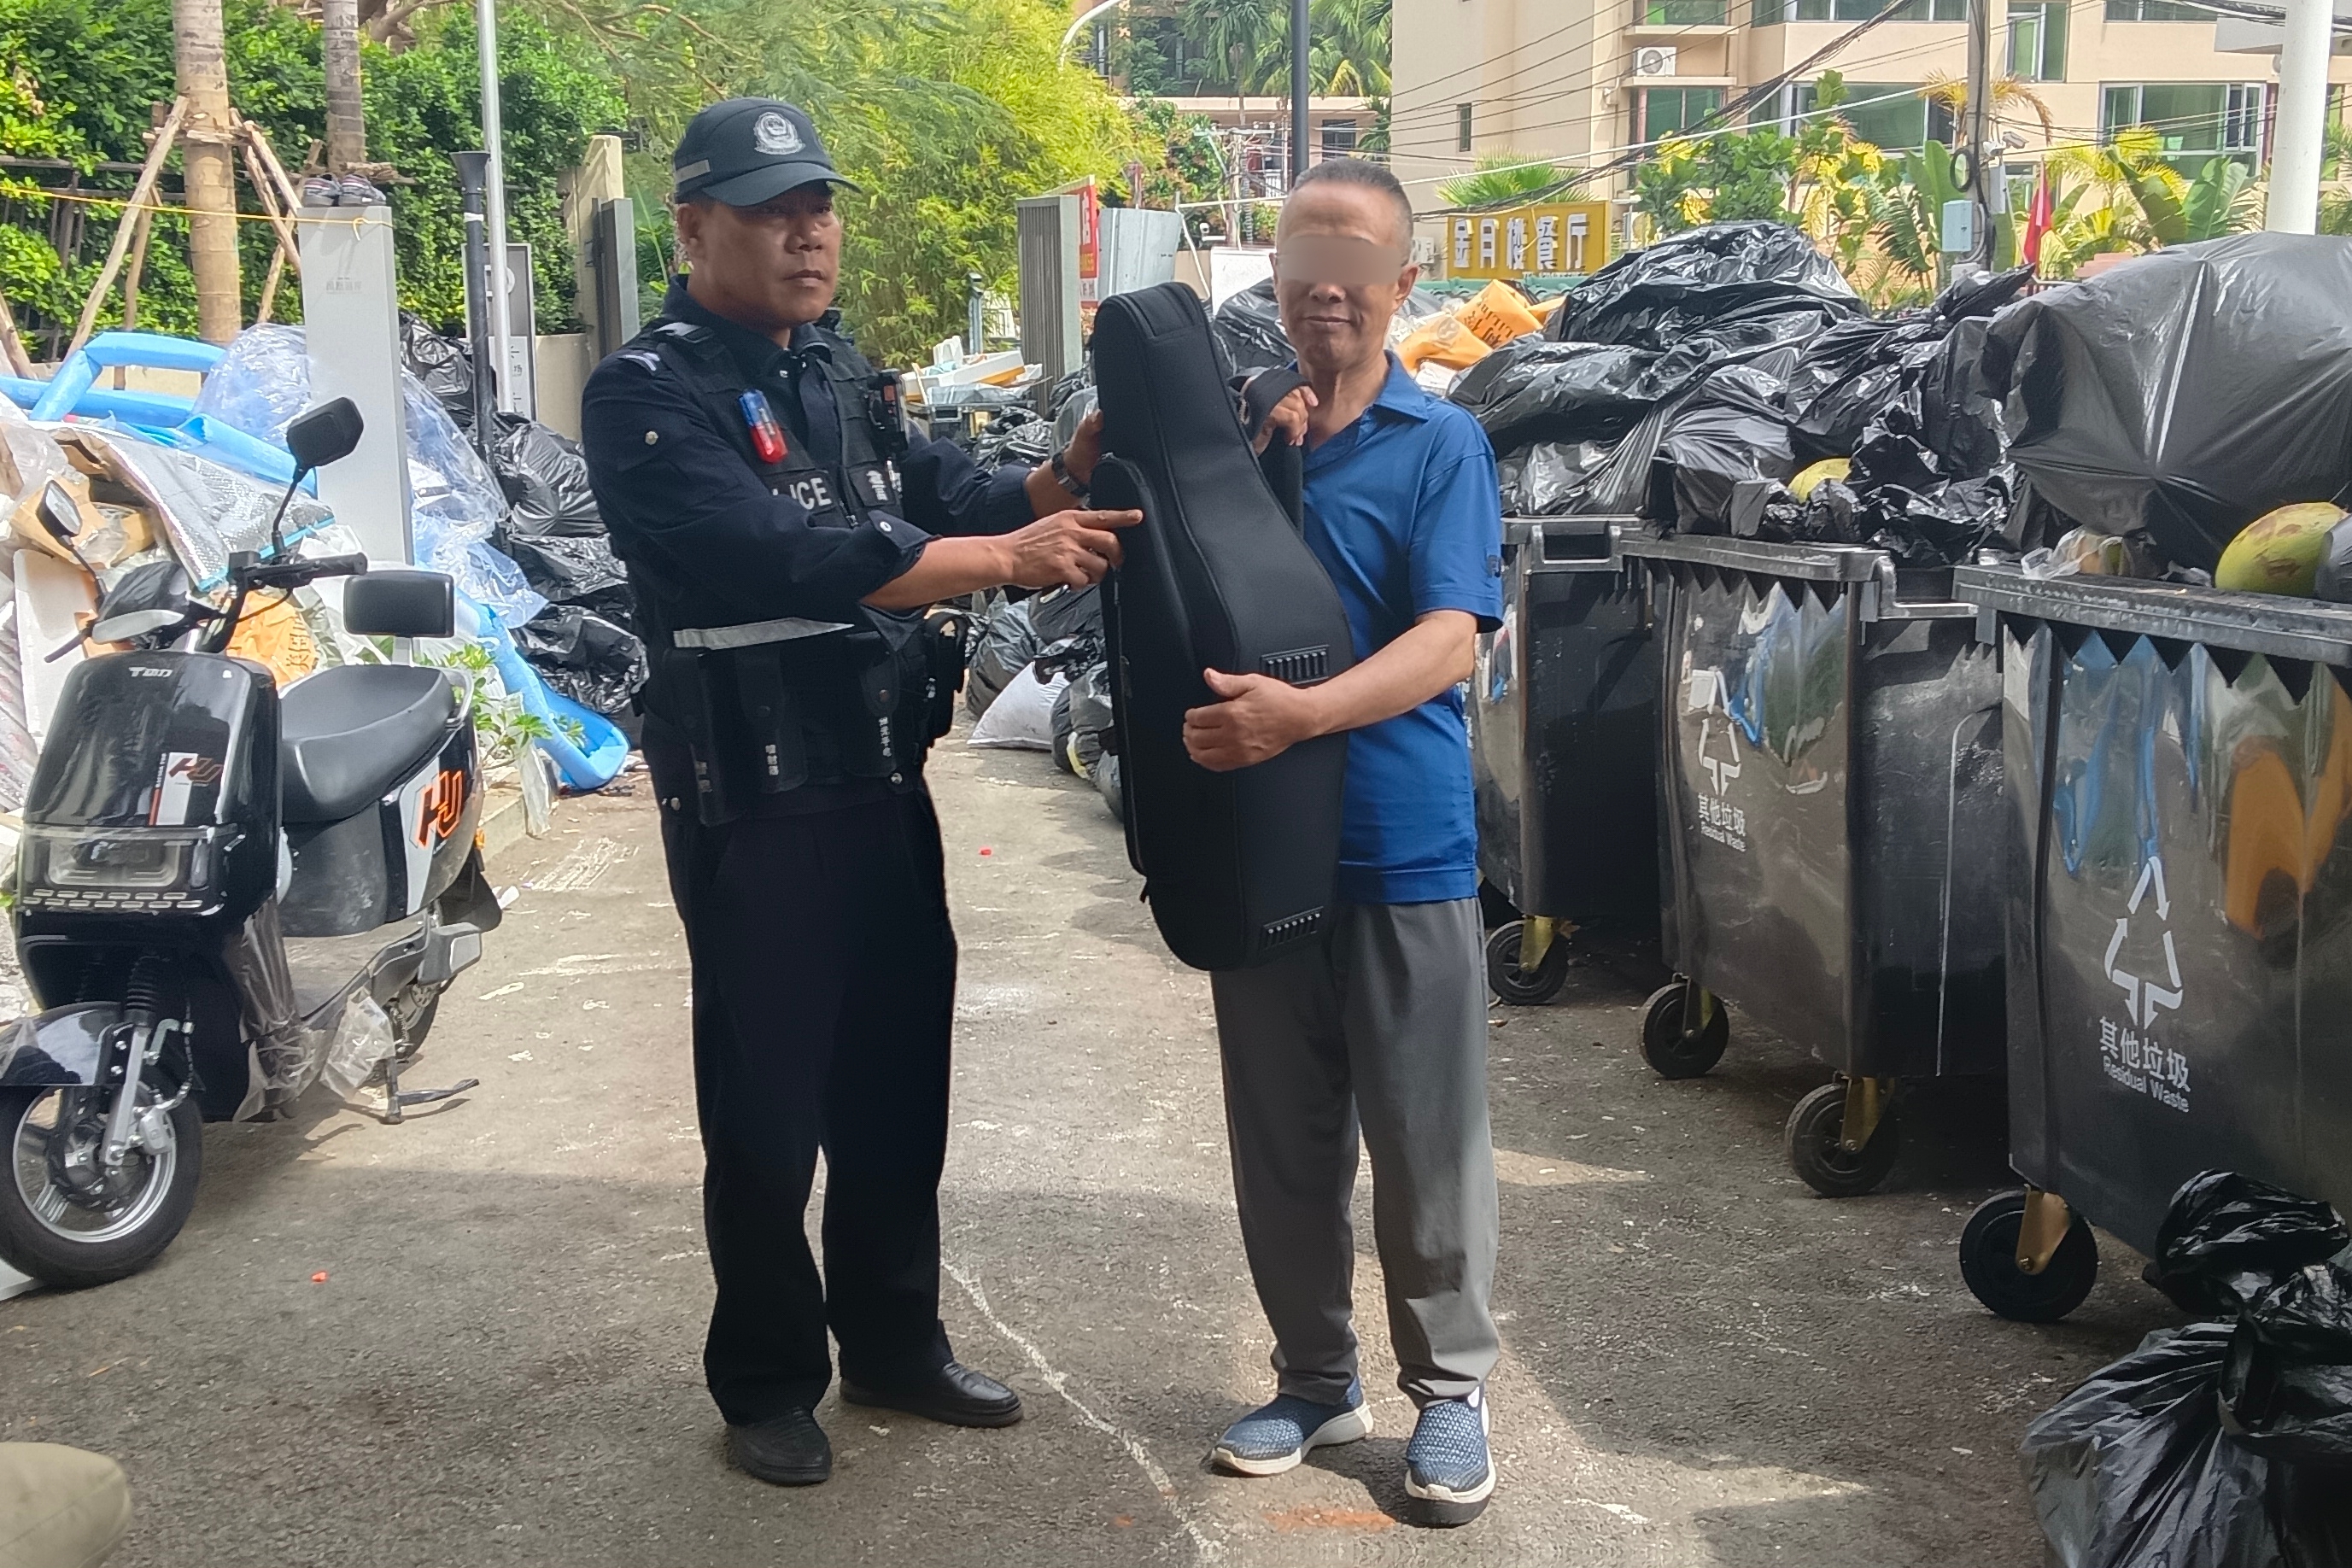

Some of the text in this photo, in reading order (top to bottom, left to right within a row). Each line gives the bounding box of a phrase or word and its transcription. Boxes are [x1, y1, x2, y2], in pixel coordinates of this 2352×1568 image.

[1698, 793, 1746, 837] 其他垃圾
[1725, 830, 1746, 852] Waste
[2100, 1016, 2191, 1092] 其他垃圾
[2103, 1056, 2190, 1113] Residual Waste
